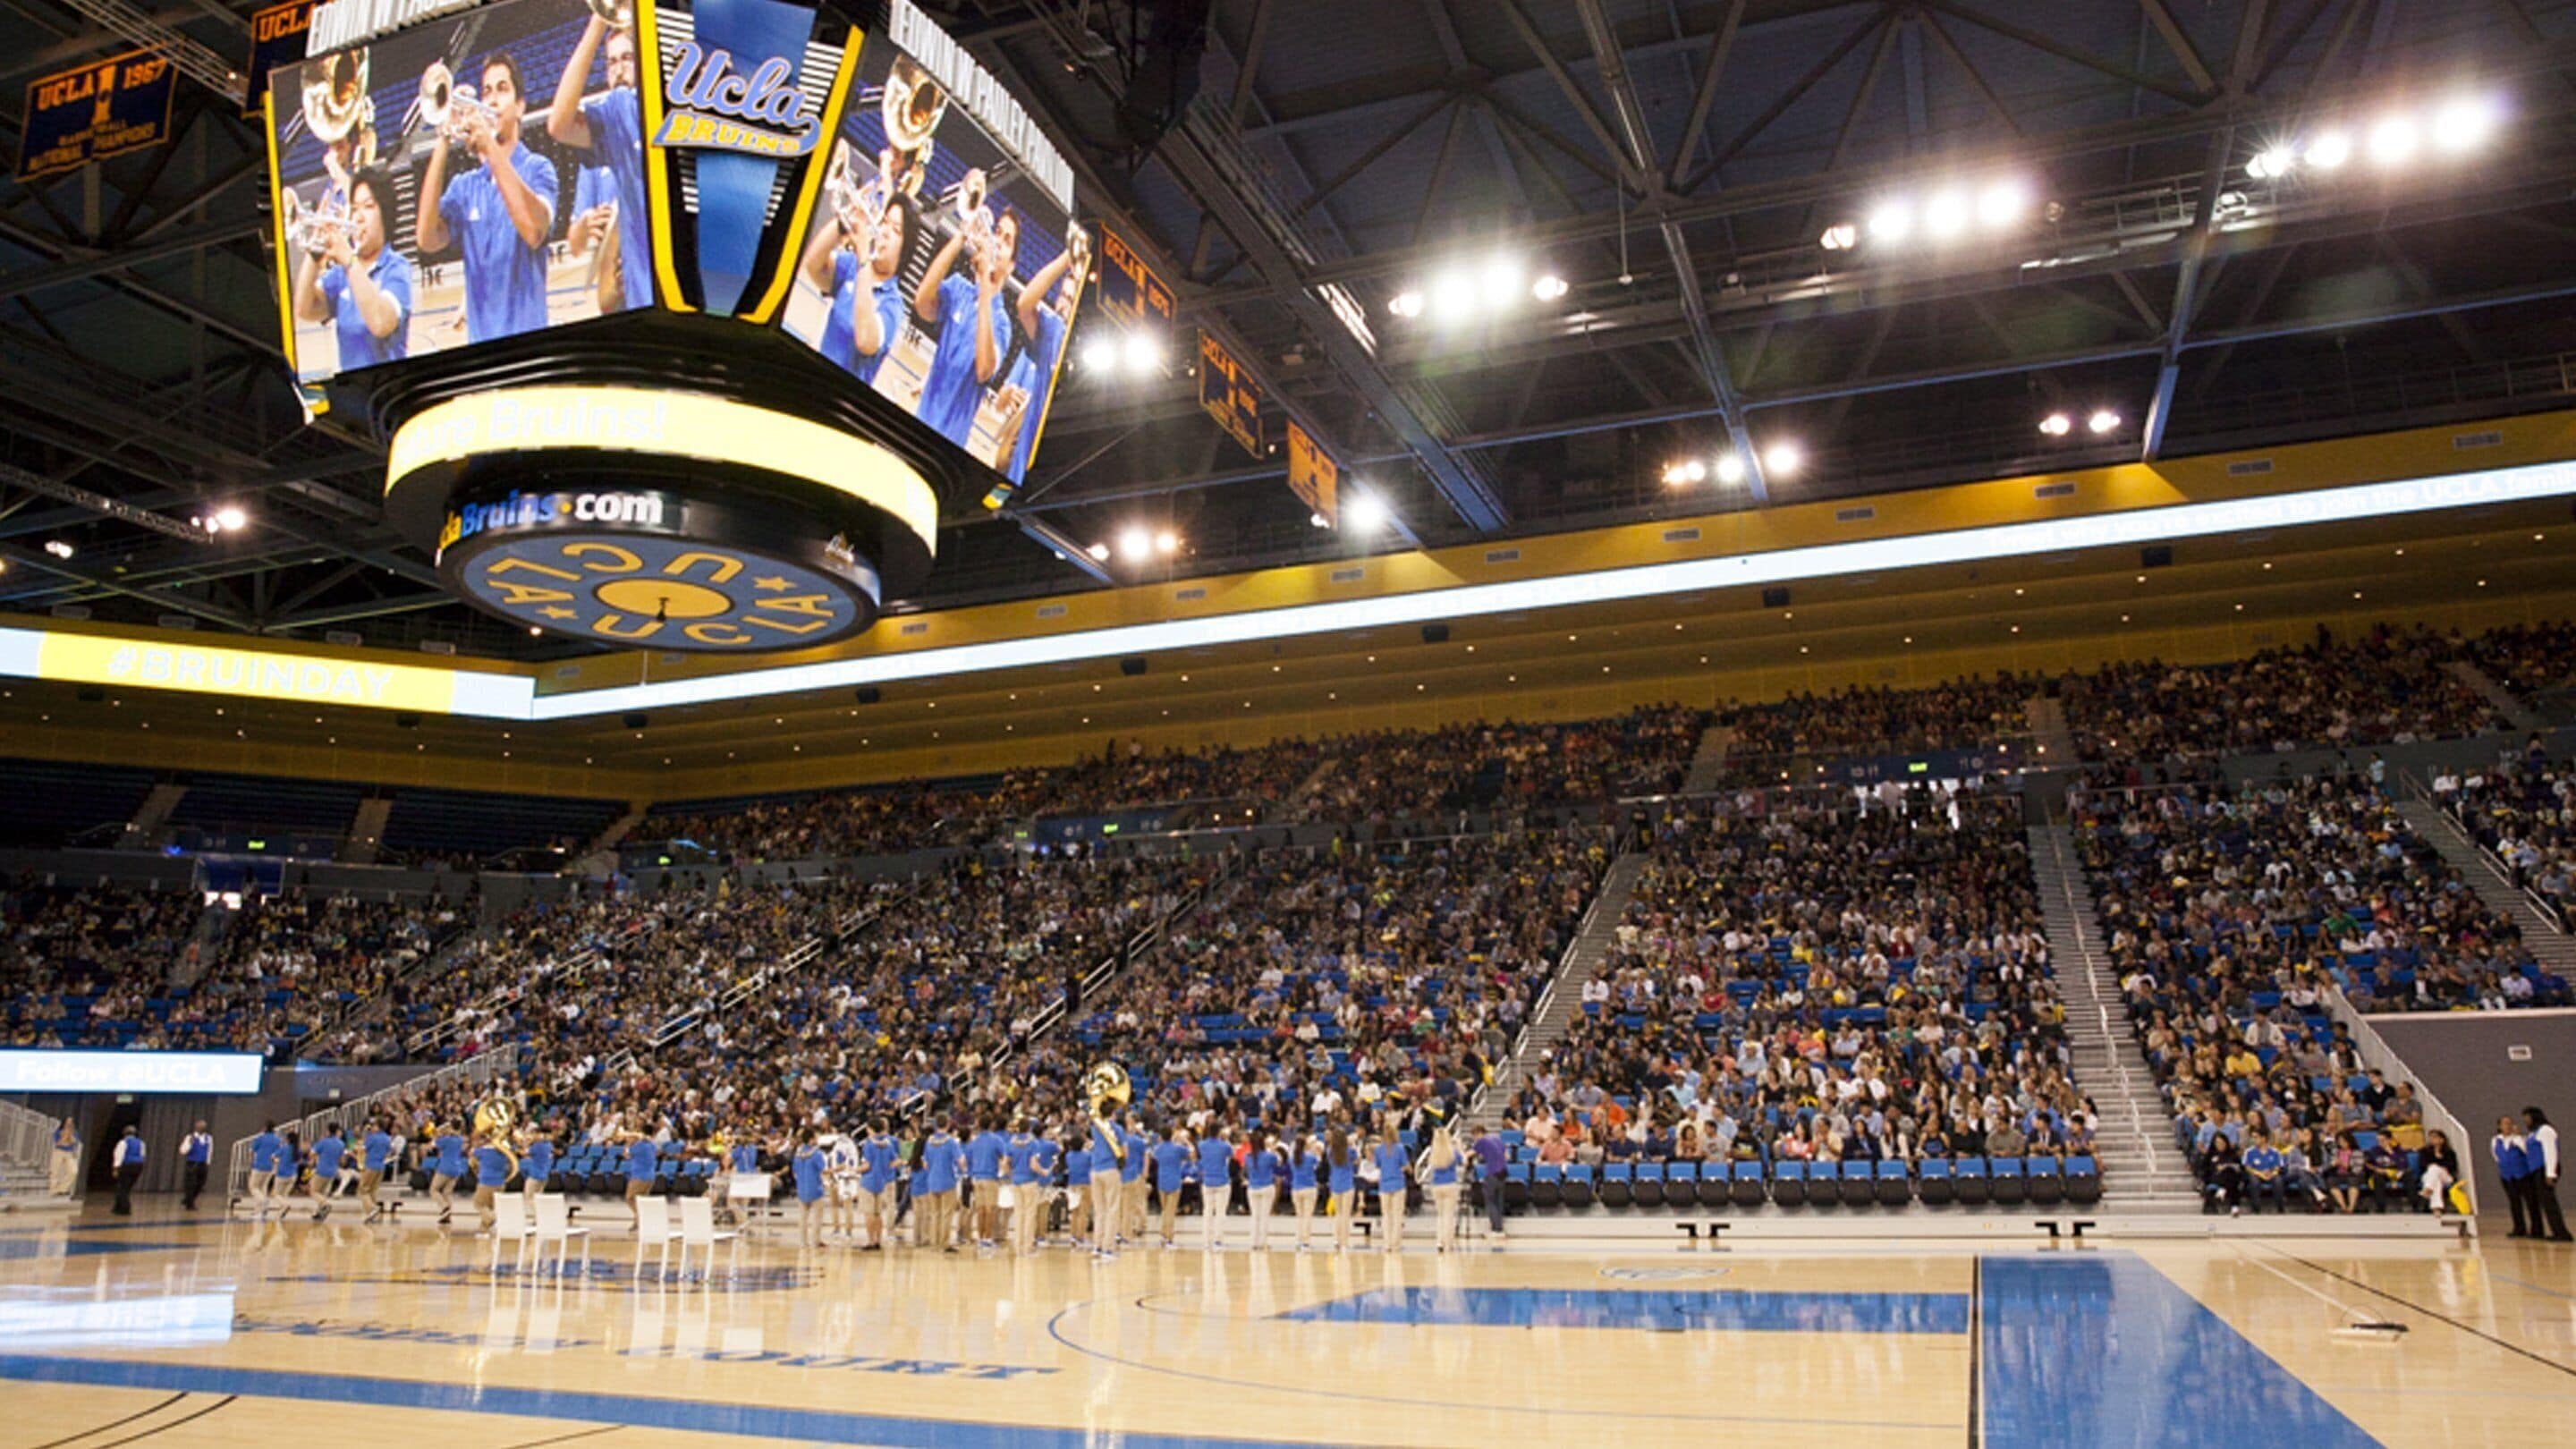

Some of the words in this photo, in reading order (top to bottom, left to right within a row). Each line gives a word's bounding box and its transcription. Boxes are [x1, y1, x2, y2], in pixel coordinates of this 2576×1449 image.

[37, 72, 95, 112] UCLA
[123, 56, 168, 90] 1967
[664, 113, 801, 154] BRUINS
[489, 397, 668, 440] Bruins!
[2421, 475, 2498, 504] UCLA
[106, 646, 395, 701] #BRUINDAY
[16, 1058, 110, 1083] Follow
[118, 1061, 225, 1087] @UCLA
